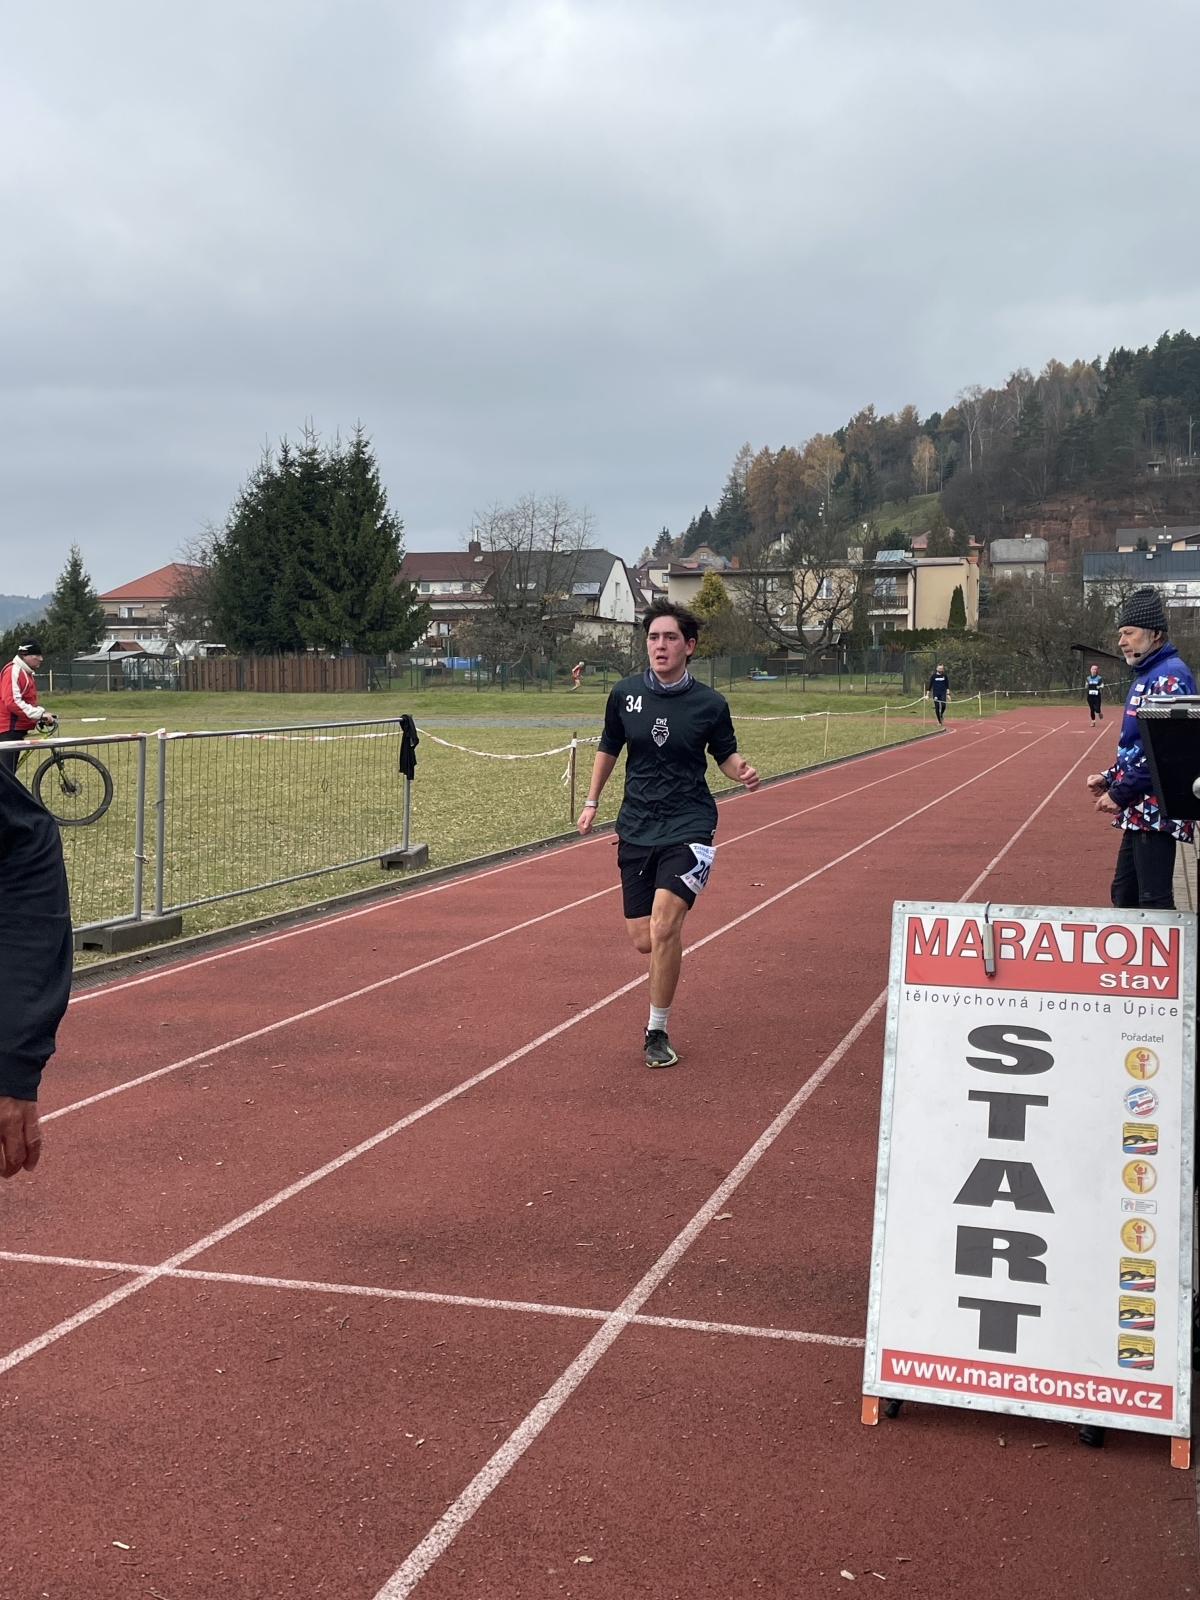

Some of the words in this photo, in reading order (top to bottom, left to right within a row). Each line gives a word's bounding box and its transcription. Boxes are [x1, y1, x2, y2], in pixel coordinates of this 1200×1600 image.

[625, 694, 643, 713] 34
[906, 916, 1180, 968] MARATON
[1099, 970, 1170, 991] stav
[905, 989, 1029, 1009] tělovýchovná
[1038, 999, 1112, 1014] jednota
[1122, 1001, 1179, 1017] Úpice
[1121, 1032, 1164, 1043] Pořadatel
[952, 1024, 1056, 1354] START
[890, 1357, 1163, 1411] www.maratonstav.cz
